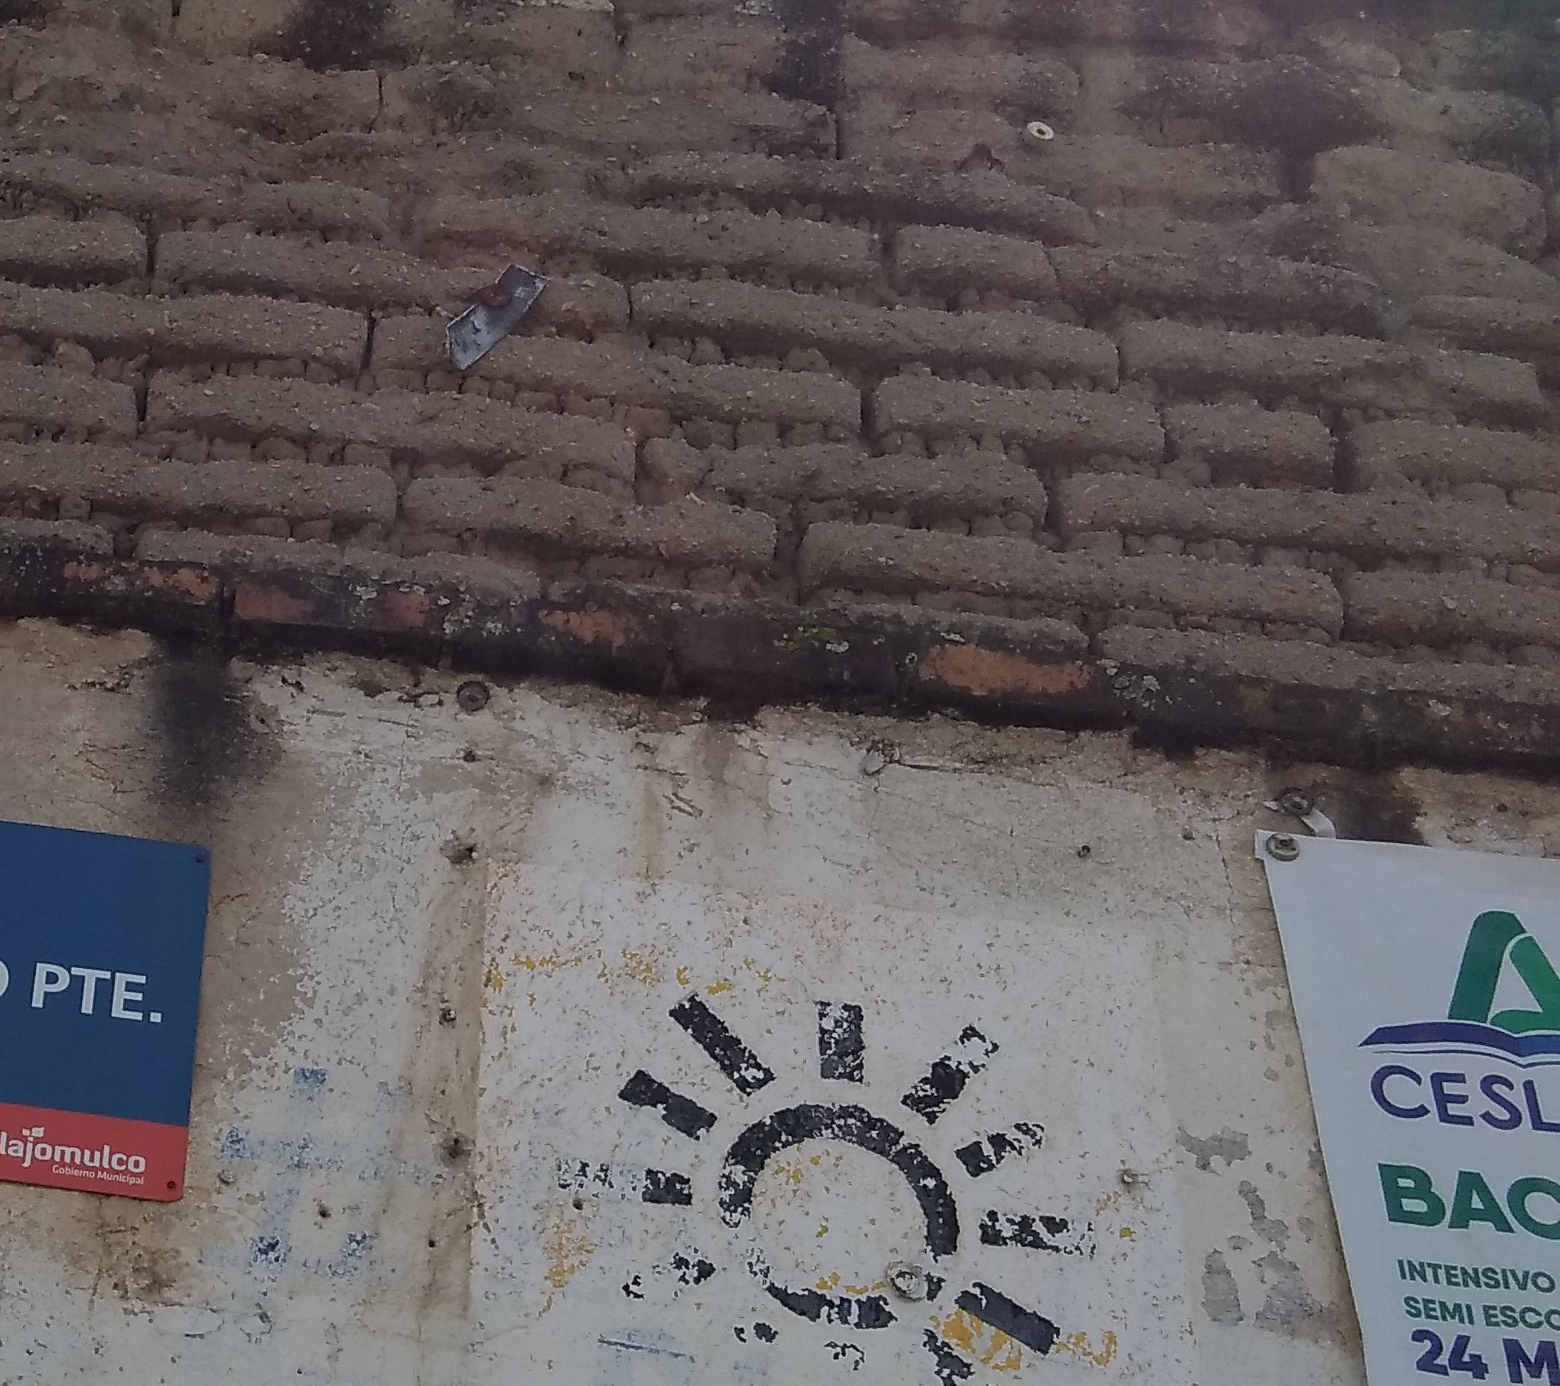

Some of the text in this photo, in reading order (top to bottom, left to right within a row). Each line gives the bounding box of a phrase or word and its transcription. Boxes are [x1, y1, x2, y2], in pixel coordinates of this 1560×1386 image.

[31, 962, 162, 1024] PTE.
[1370, 1065, 1560, 1133] CESL
[52, 1164, 144, 1186] Gobierno Municipal
[1377, 1163, 1560, 1240] BAC
[1397, 1259, 1556, 1293] INTENSIVO
[1403, 1296, 1475, 1326] SEMI
[1410, 1329, 1489, 1380] 24
